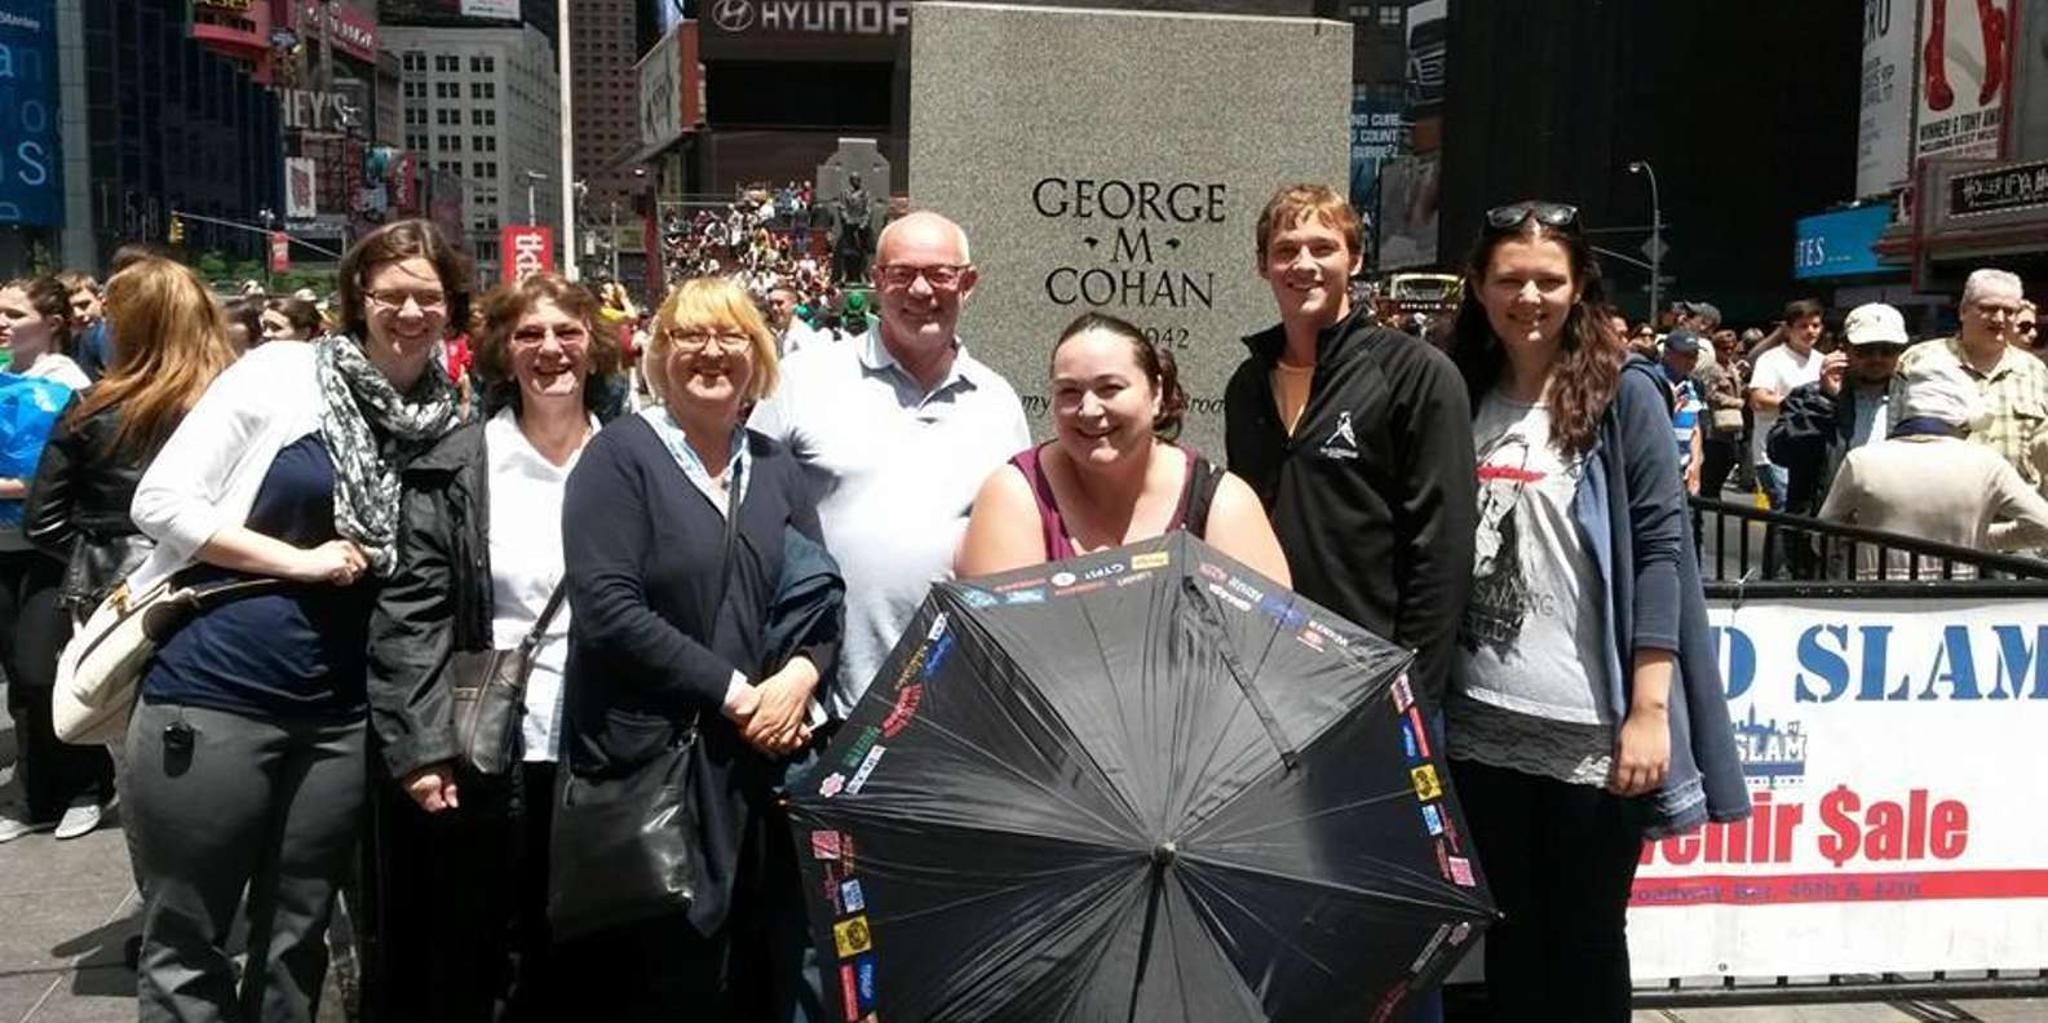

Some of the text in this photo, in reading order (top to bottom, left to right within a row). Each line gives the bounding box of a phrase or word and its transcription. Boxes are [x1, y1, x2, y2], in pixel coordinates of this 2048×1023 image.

[1032, 178, 1226, 223] GEORGE
[1110, 226, 1153, 264] M
[1045, 267, 1213, 310] COHAN
[1795, 625, 2048, 703] SLAM
[1817, 785, 1970, 868] $ale
